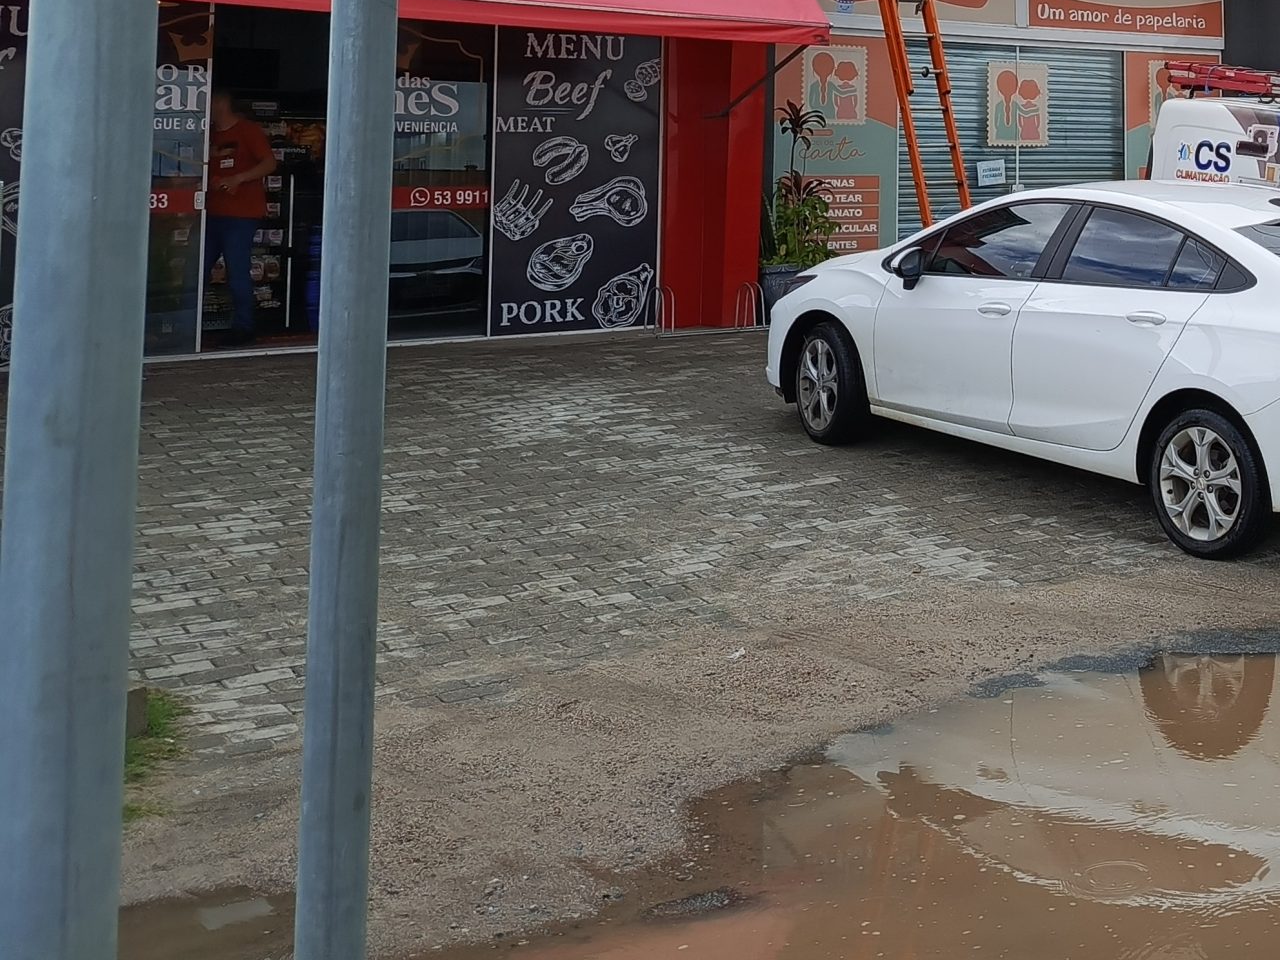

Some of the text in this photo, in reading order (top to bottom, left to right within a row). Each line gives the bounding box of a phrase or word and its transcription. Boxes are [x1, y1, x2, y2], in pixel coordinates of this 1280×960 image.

[1037, 2, 1206, 31] Um amor de papelaria
[524, 32, 625, 61] MENU
[397, 72, 431, 89] das
[523, 68, 613, 121] Beef
[496, 116, 555, 133] MEAT
[1194, 140, 1232, 173] CS
[433, 191, 452, 206] 53
[835, 194, 863, 203] TEAR
[500, 296, 586, 326] PORK
